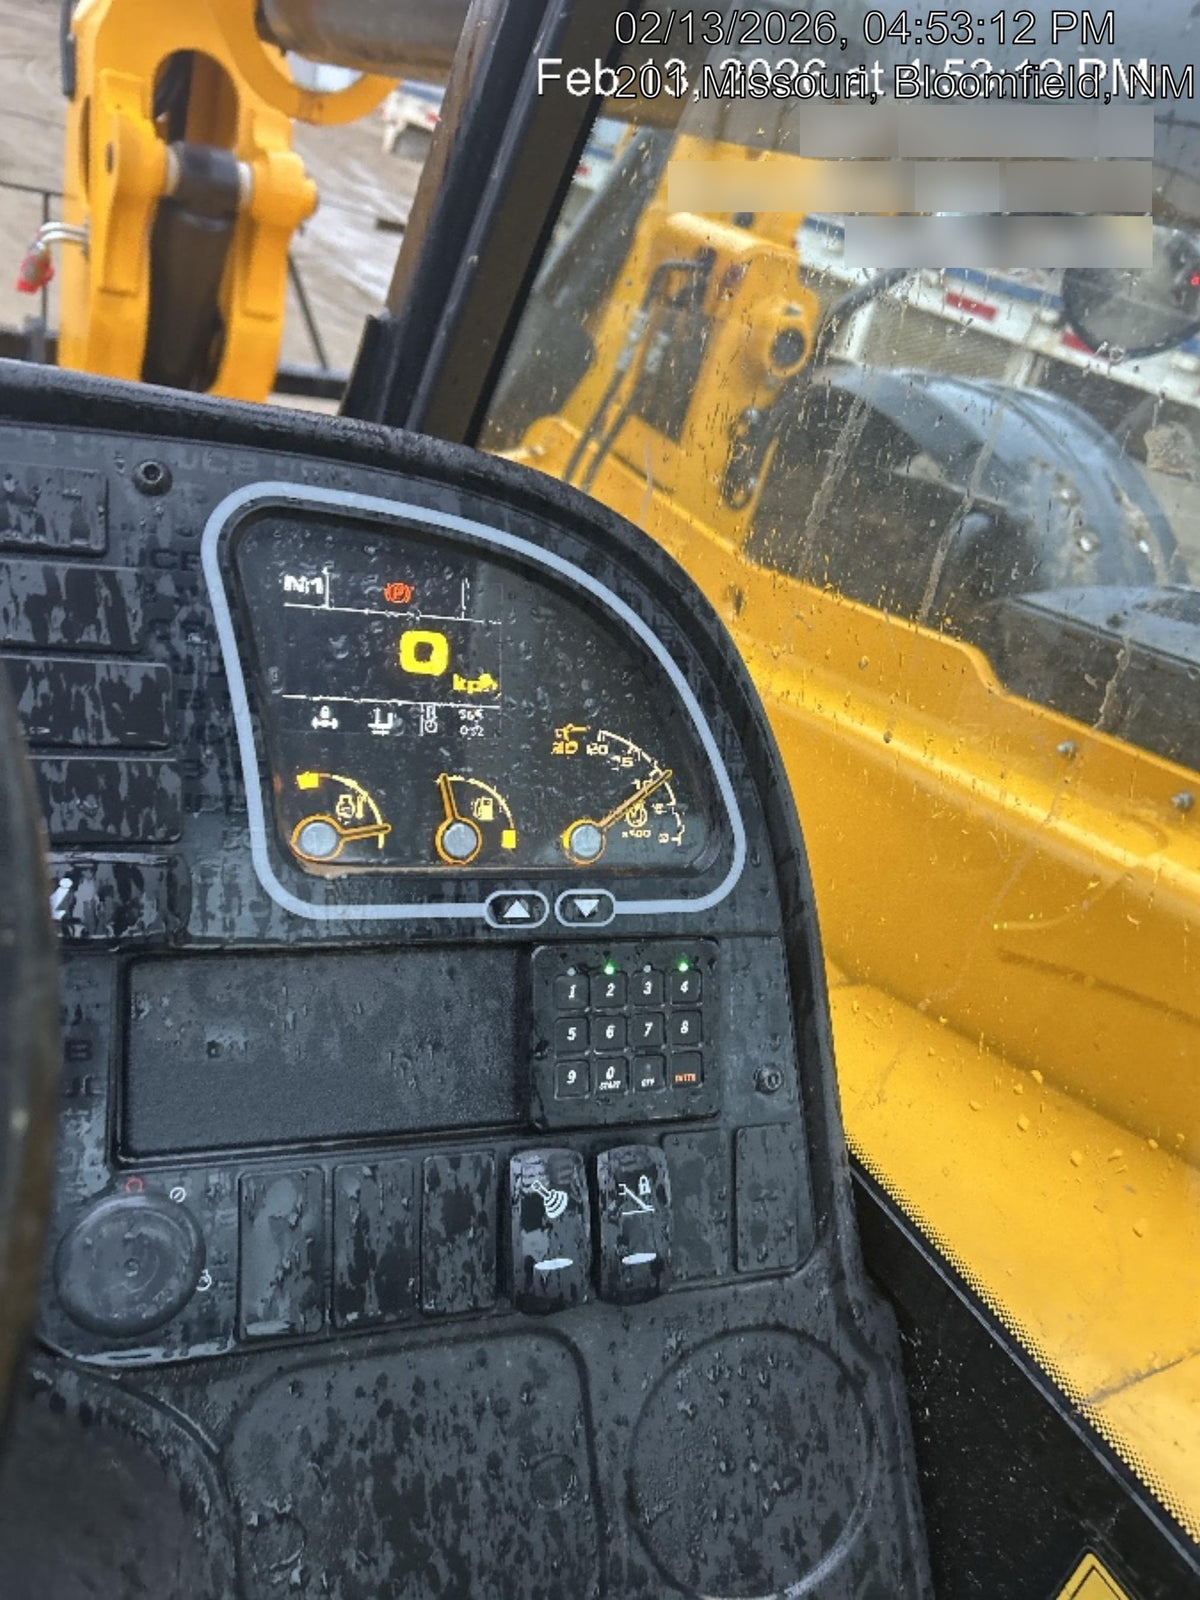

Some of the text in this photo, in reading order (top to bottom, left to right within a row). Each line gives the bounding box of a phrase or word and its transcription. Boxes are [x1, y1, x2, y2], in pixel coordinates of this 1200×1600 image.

[568, 980, 689, 999] 1 2 3 4
[566, 1020, 689, 1041] 5 6 7 8
[566, 1066, 615, 1084] 9 0
